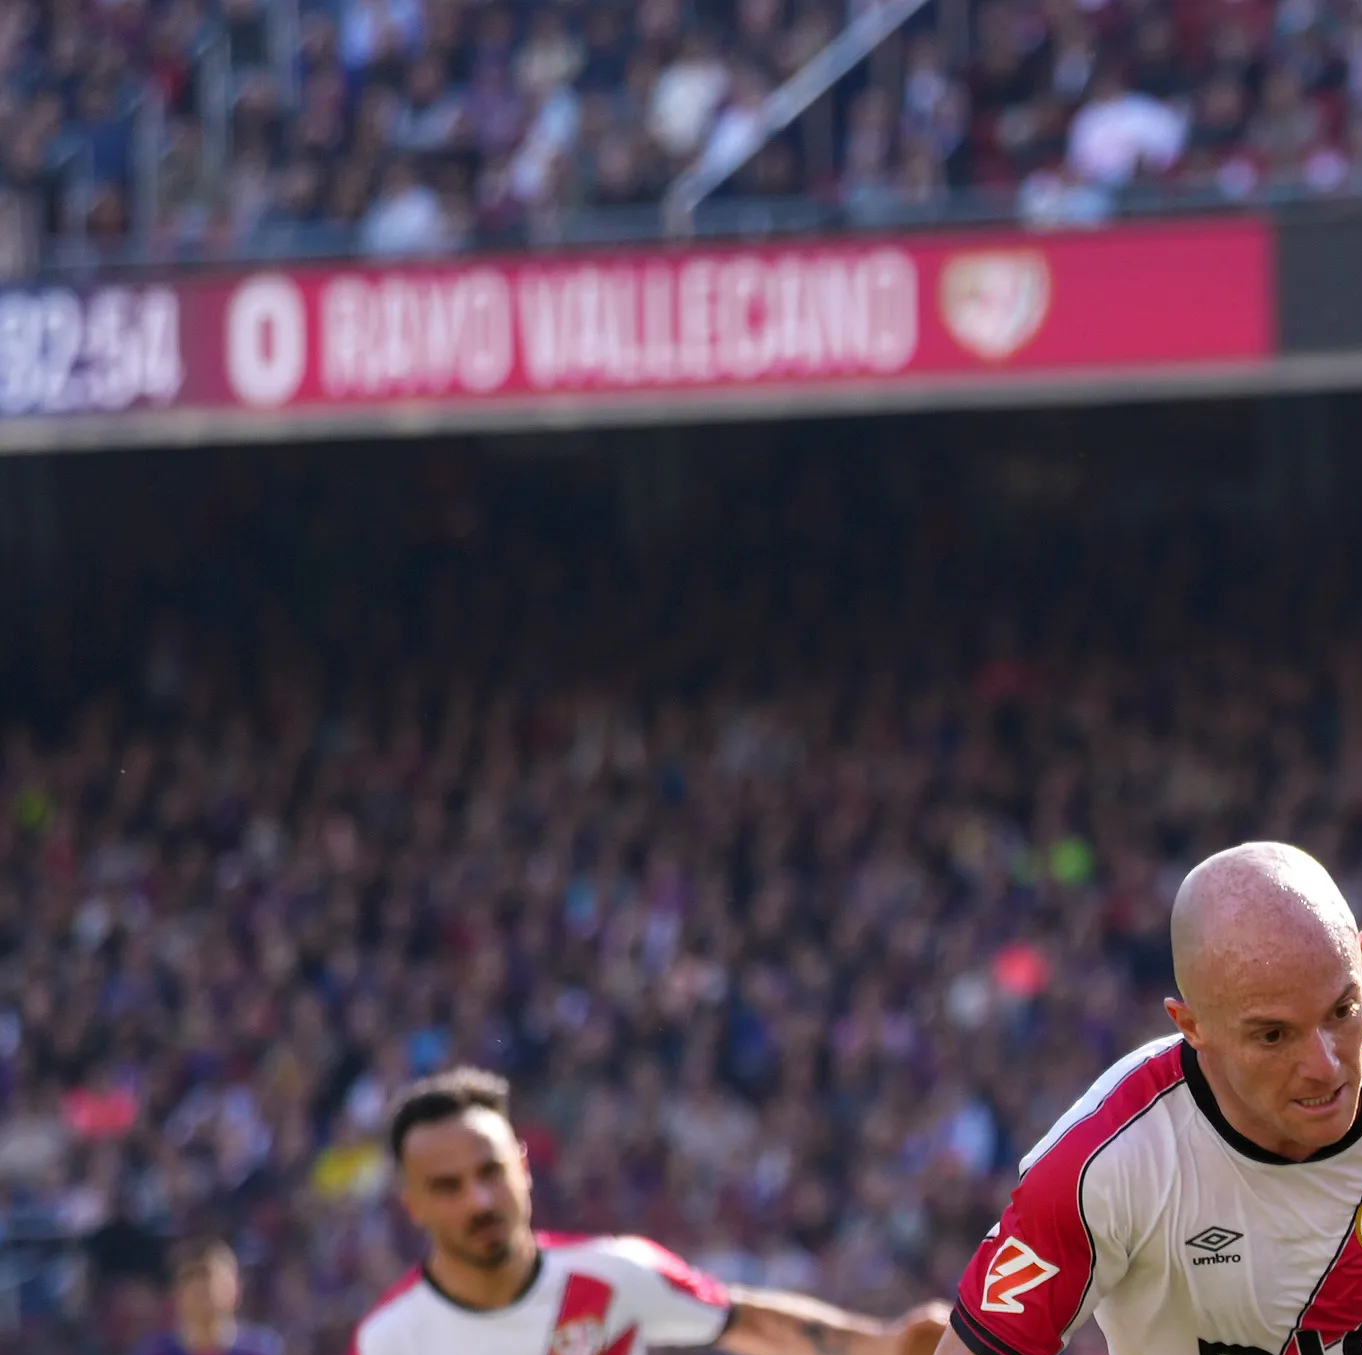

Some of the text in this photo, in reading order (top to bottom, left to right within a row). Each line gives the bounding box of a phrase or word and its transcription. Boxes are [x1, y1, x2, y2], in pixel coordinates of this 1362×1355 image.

[322, 266, 514, 398] RAYO
[518, 246, 920, 392] VALLECANO
[1192, 1253, 1242, 1266] umbro
